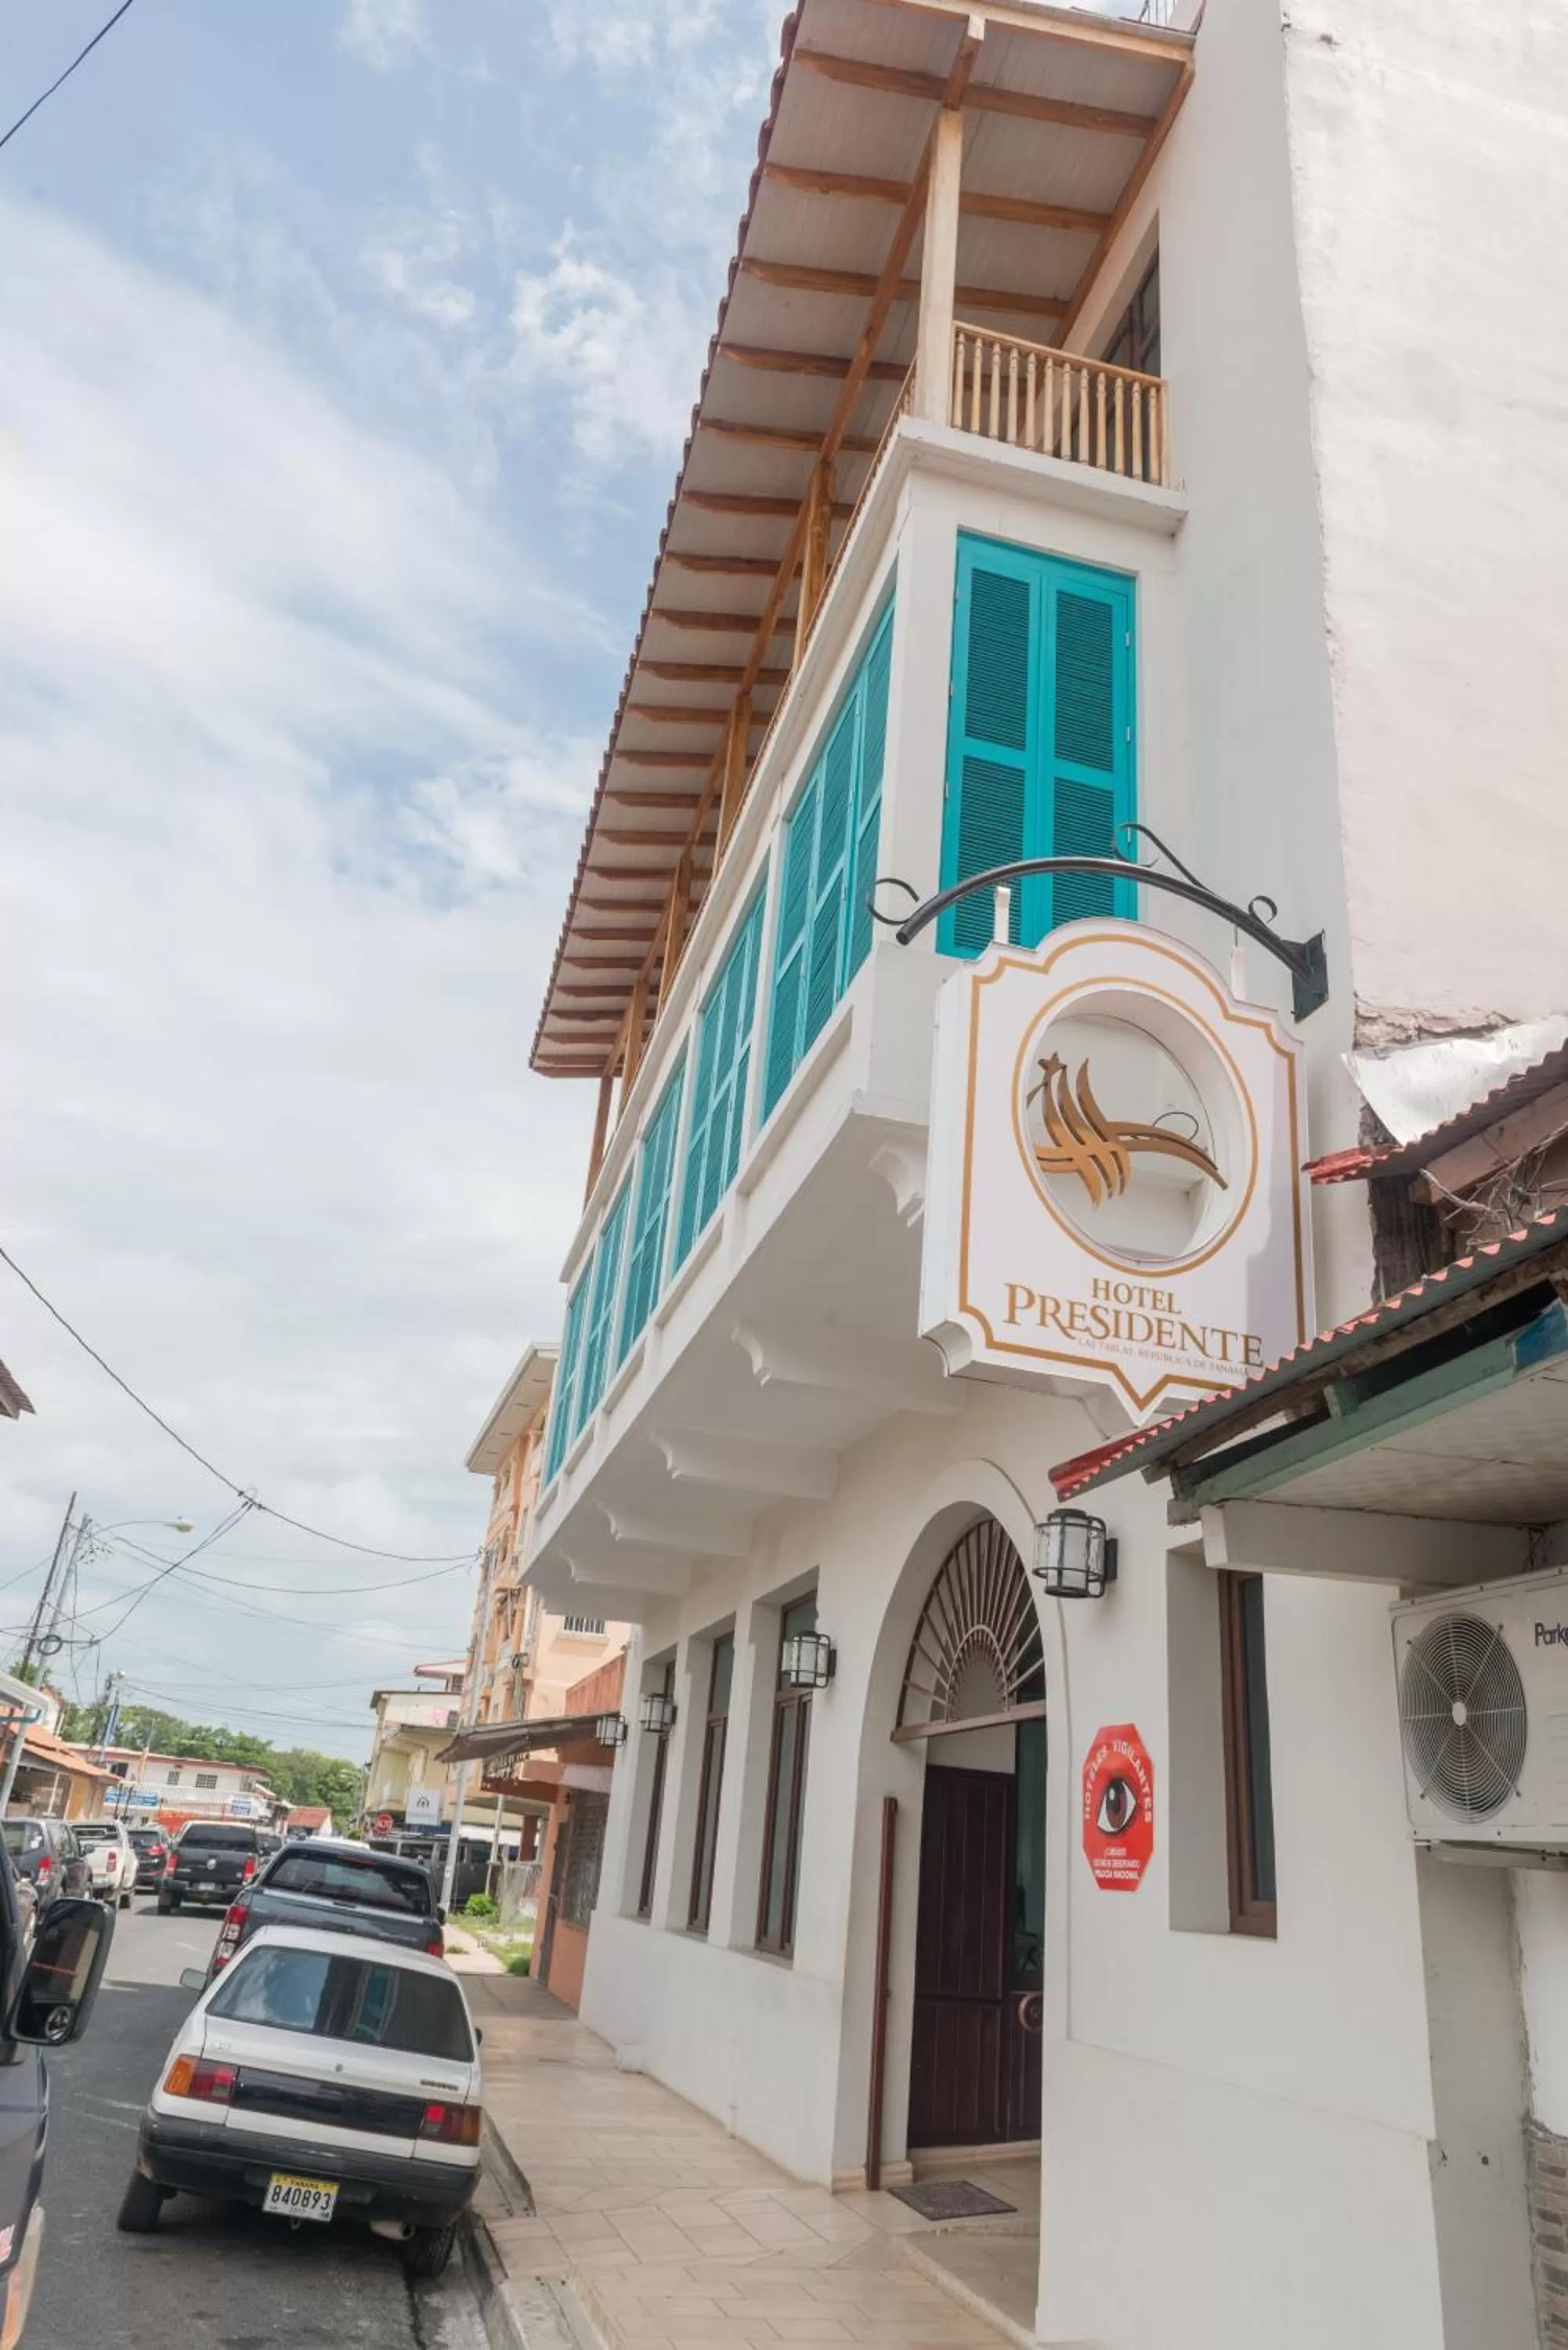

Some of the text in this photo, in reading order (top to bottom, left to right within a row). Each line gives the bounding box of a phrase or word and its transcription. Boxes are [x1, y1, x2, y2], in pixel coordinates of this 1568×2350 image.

[1003, 1282, 1264, 1368] PRESIDENTE
[1091, 1277, 1182, 1315] HOTEL
[1113, 1739, 1152, 1823] VIGILANTES
[272, 2185, 331, 2211] 840893
